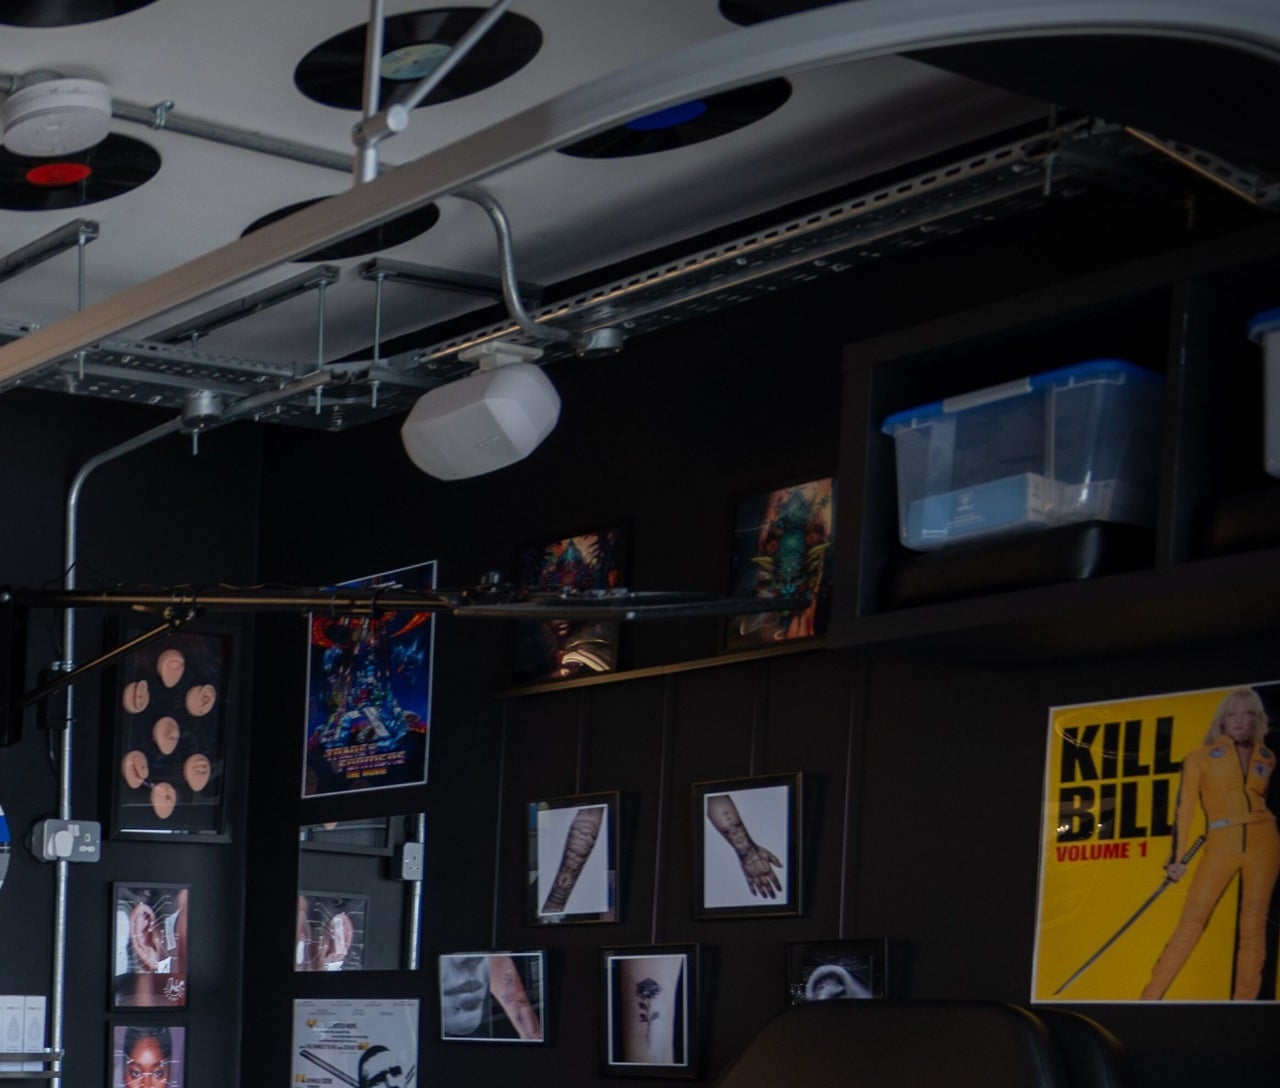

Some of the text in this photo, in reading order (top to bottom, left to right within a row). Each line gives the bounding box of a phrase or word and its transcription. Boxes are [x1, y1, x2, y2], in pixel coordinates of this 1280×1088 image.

[1061, 716, 1183, 783] KILL
[1057, 779, 1174, 843] BILL
[1056, 841, 1149, 863] VOLUME 1
